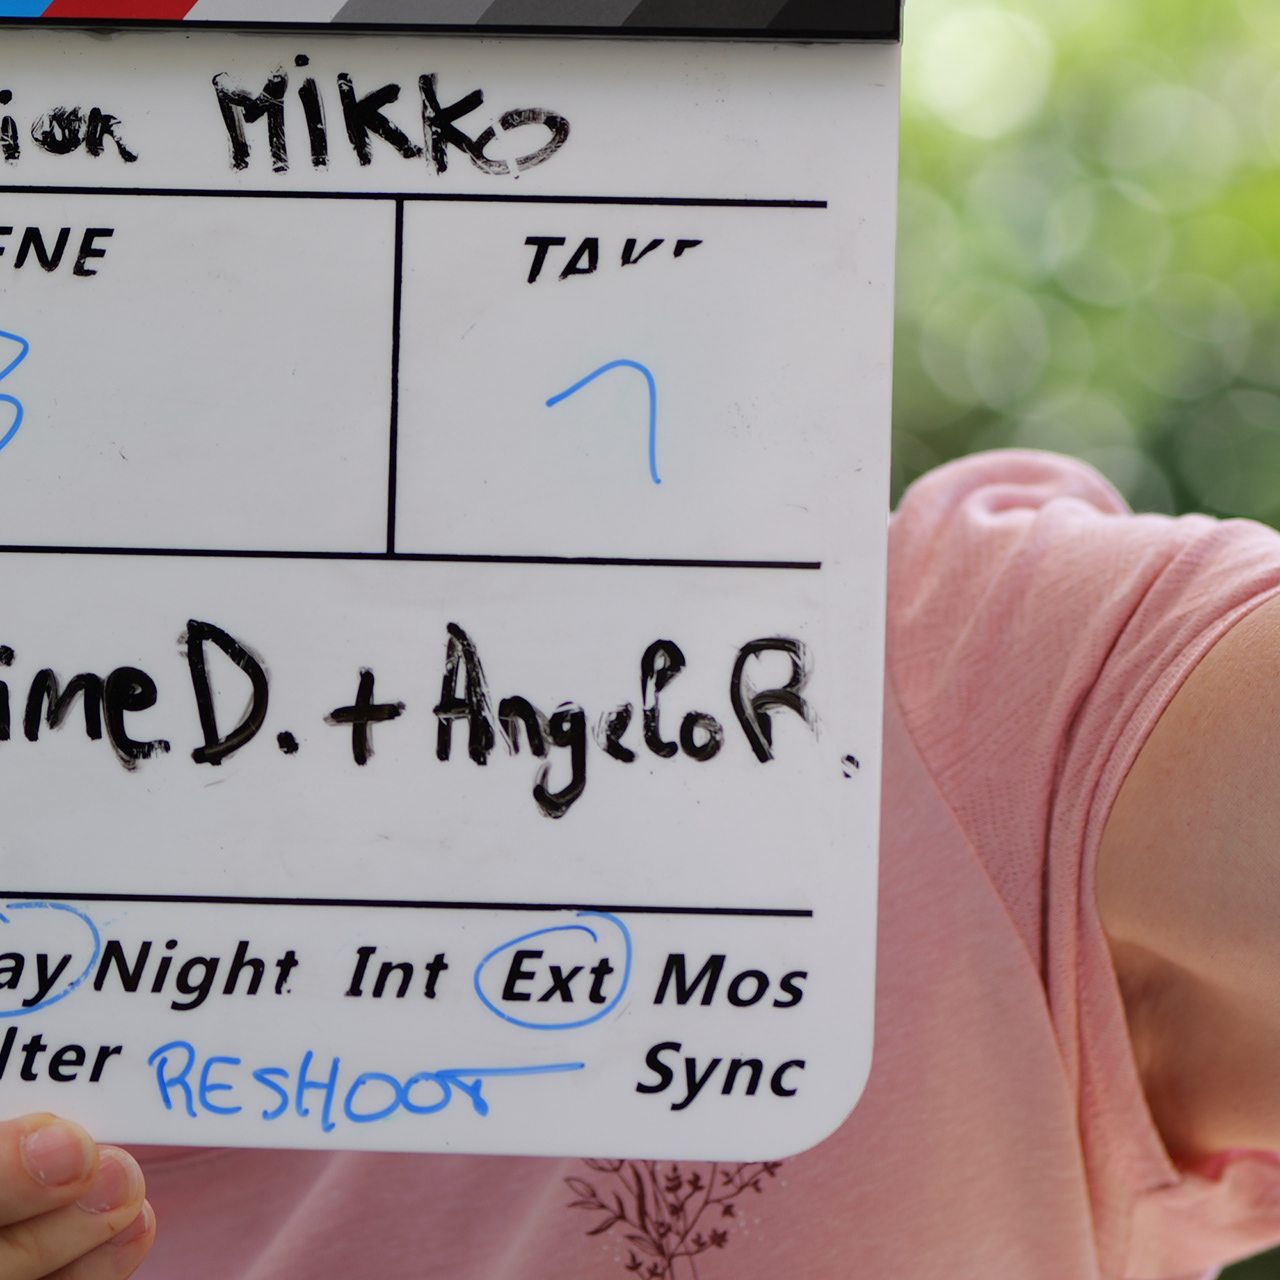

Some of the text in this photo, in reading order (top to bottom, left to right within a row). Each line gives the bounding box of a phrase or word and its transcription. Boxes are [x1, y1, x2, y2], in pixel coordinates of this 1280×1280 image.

[93, 939, 299, 998] Night
[345, 946, 449, 1000] Int
[501, 949, 614, 1005] Ext
[653, 953, 808, 1009] Mos
[635, 1041, 806, 1111] Sync
